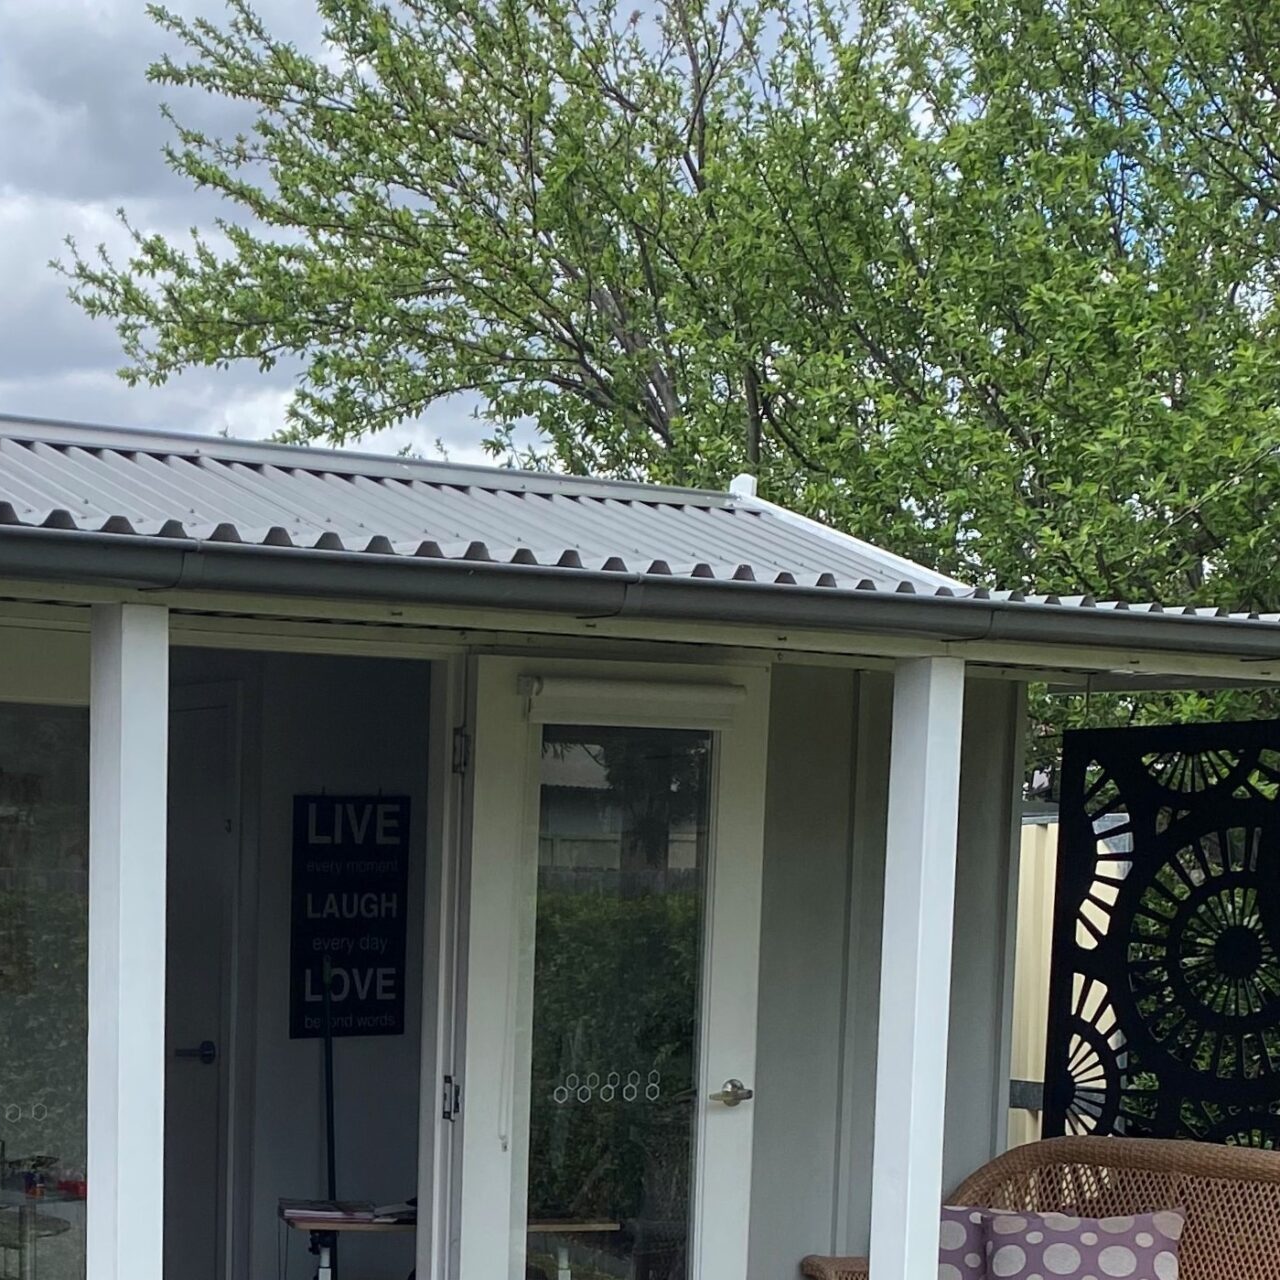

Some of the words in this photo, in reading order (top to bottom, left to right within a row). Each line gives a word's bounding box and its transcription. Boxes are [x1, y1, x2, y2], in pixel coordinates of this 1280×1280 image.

[308, 803, 400, 845] LIVE
[307, 860, 342, 877] every
[346, 858, 399, 873] moment
[307, 893, 398, 919] LAUGH
[312, 936, 354, 955] every
[359, 933, 388, 955] day
[305, 967, 396, 1001] LOVE
[304, 1012, 353, 1029] beond
[357, 1012, 396, 1027] words
